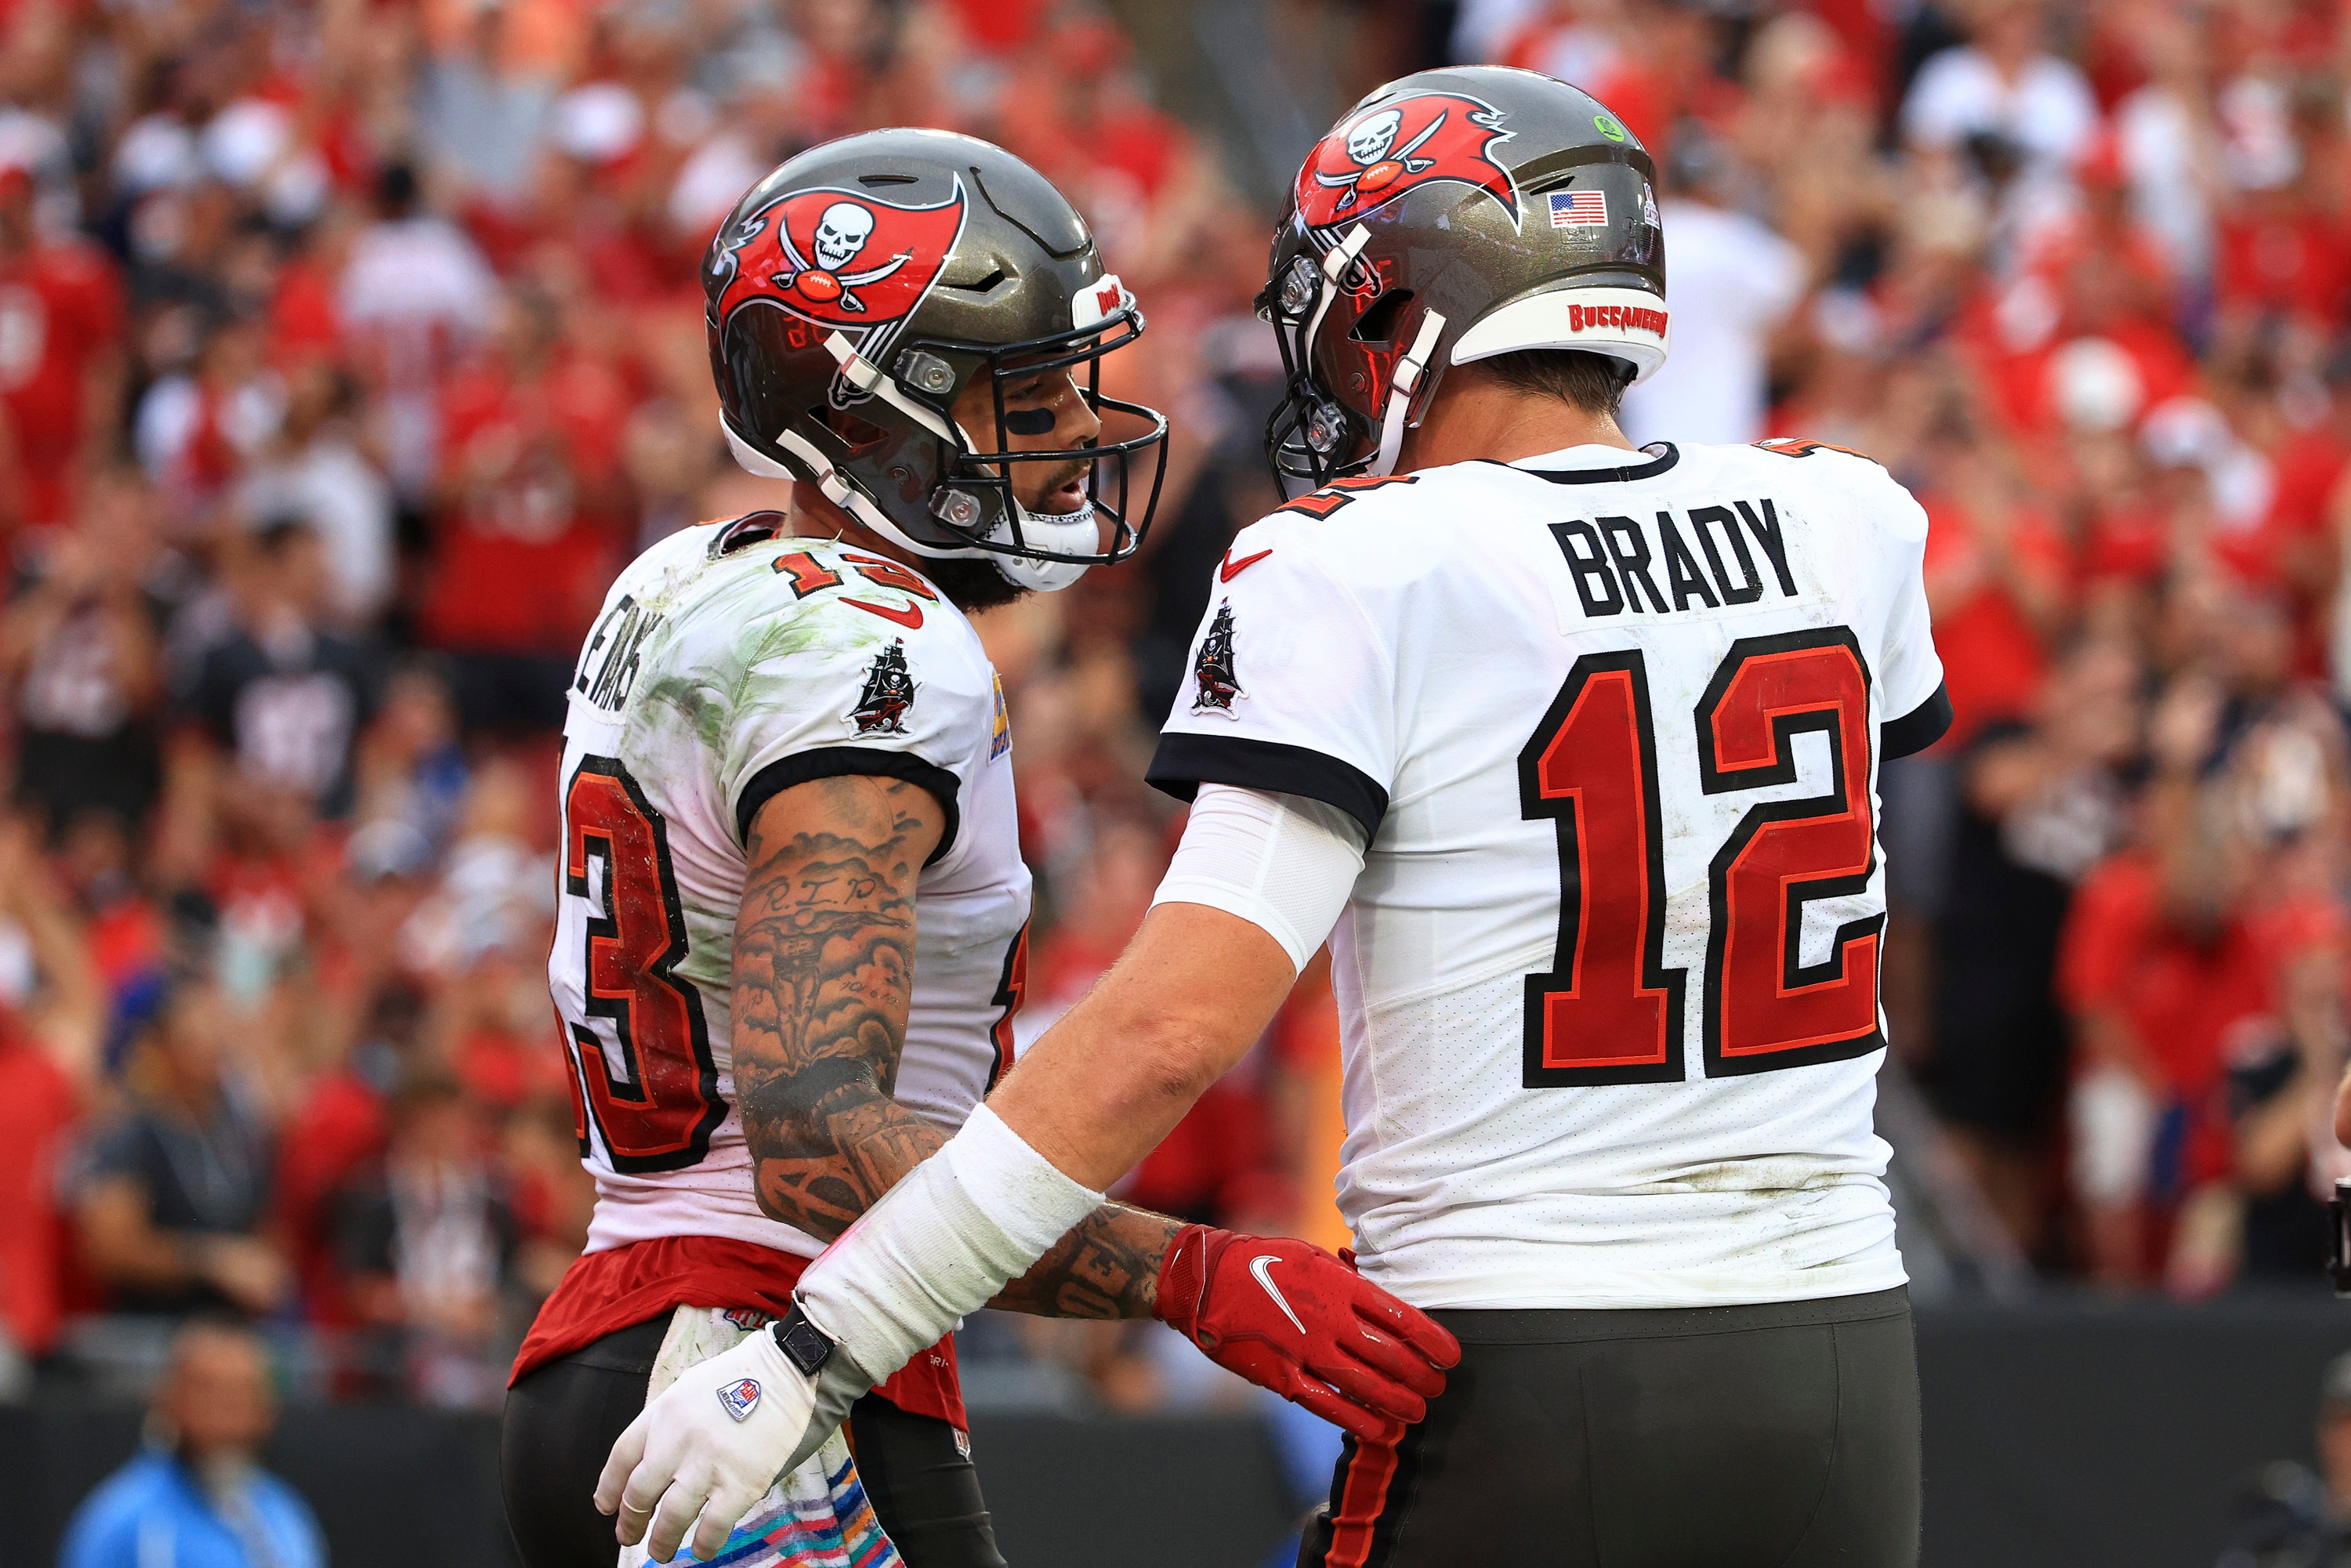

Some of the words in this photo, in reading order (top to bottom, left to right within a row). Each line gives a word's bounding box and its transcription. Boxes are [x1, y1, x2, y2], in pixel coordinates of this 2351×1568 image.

[576, 593, 665, 712] EVANS
[1547, 498, 1798, 617] BRADY
[548, 753, 729, 1173] 3
[1518, 625, 1887, 1088] 12
